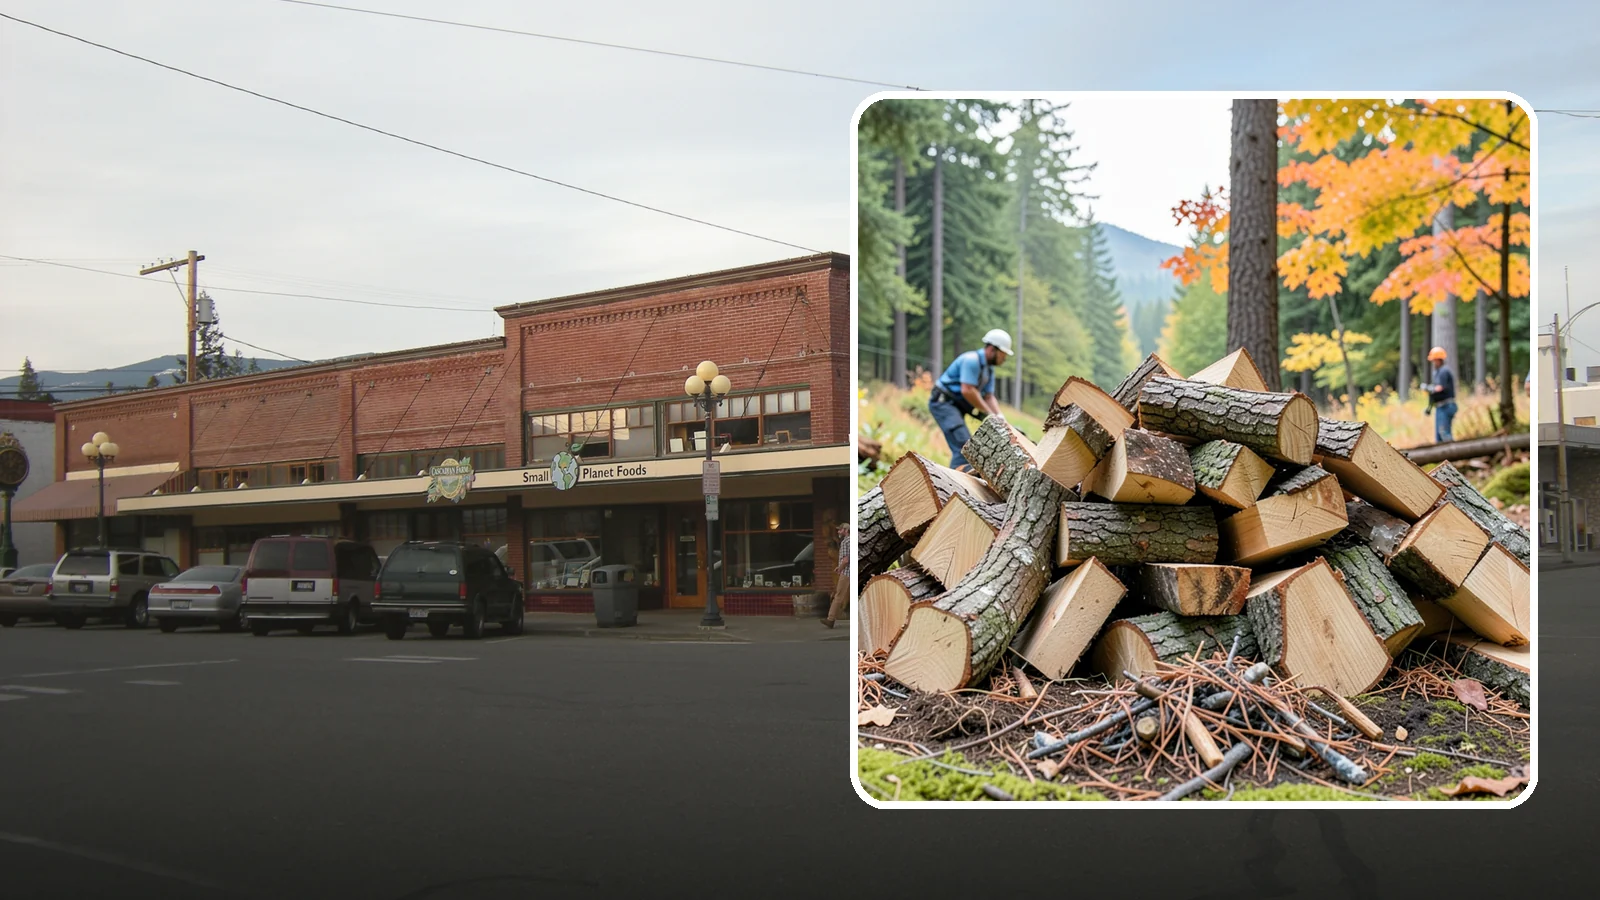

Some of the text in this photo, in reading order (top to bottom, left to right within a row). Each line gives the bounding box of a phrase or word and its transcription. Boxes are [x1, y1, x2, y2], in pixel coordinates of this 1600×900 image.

[523, 464, 647, 483] Small Planet Foods
